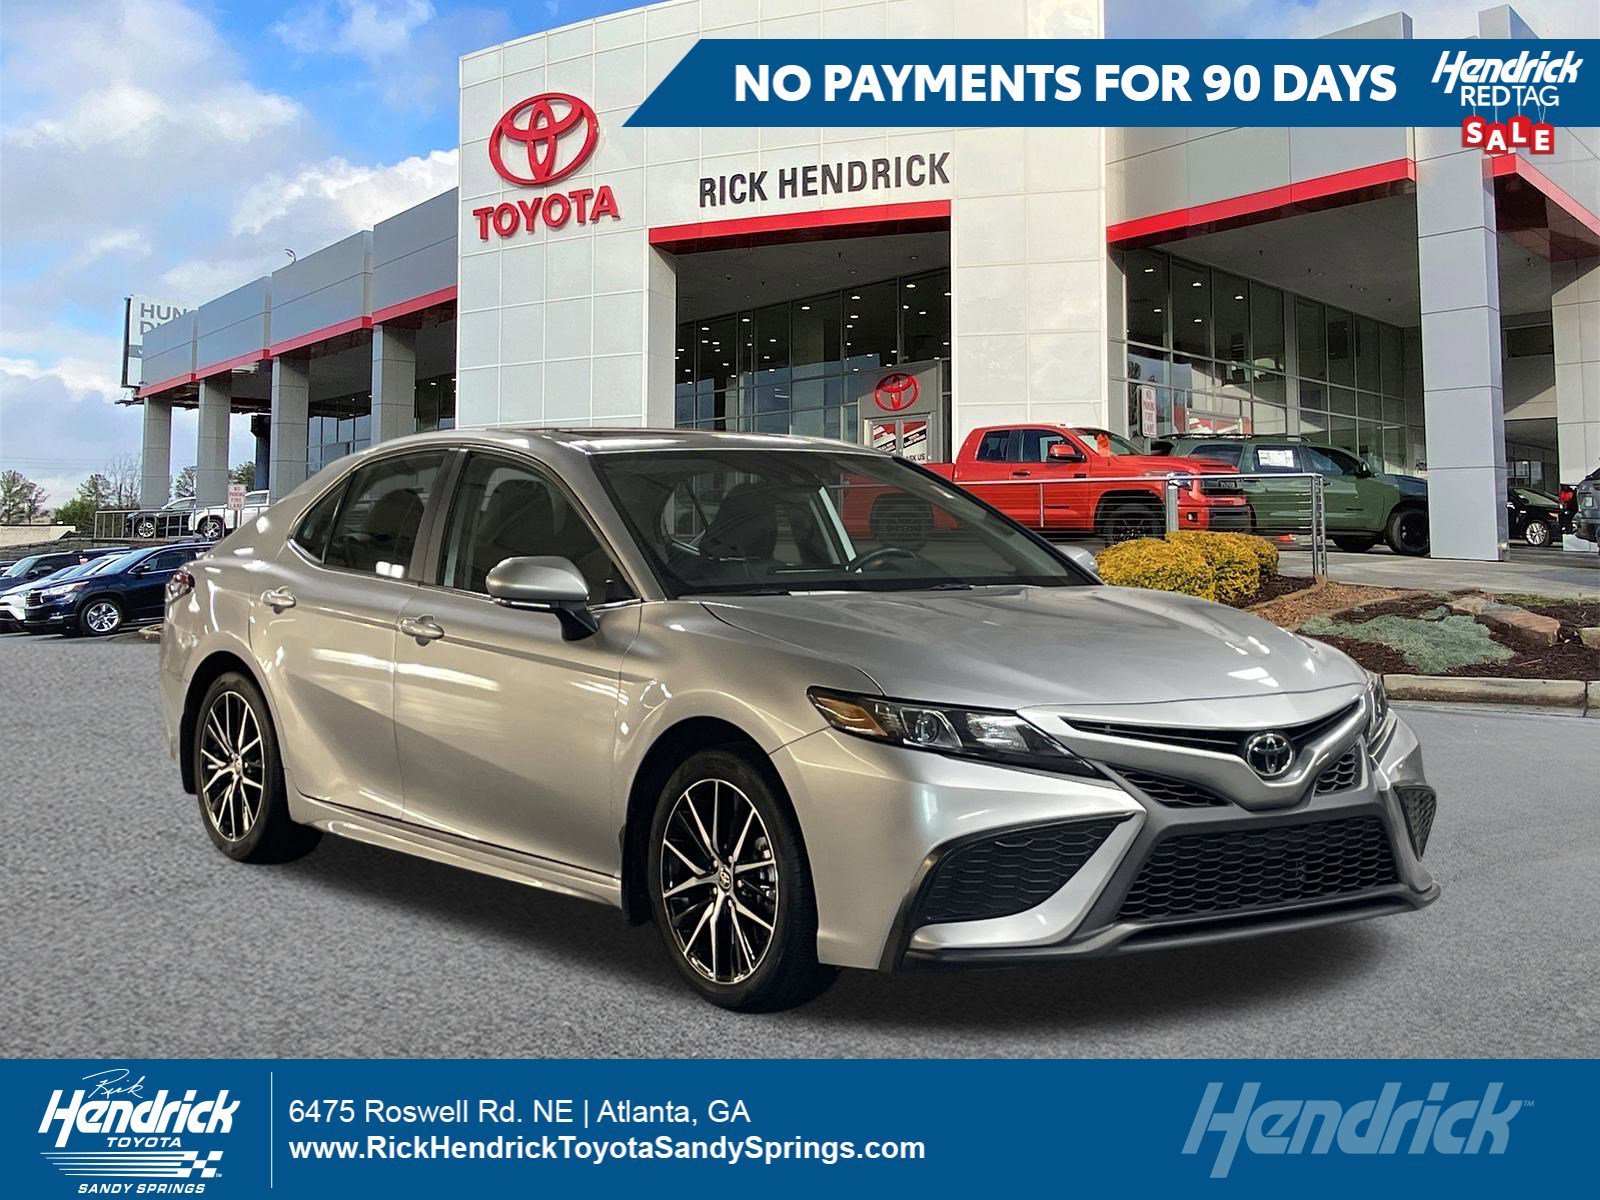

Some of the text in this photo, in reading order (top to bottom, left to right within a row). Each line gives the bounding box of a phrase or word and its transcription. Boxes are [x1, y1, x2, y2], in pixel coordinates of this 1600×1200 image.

[698, 152, 951, 208] RICK HENDRICK
[472, 184, 621, 241] TOYOTA
